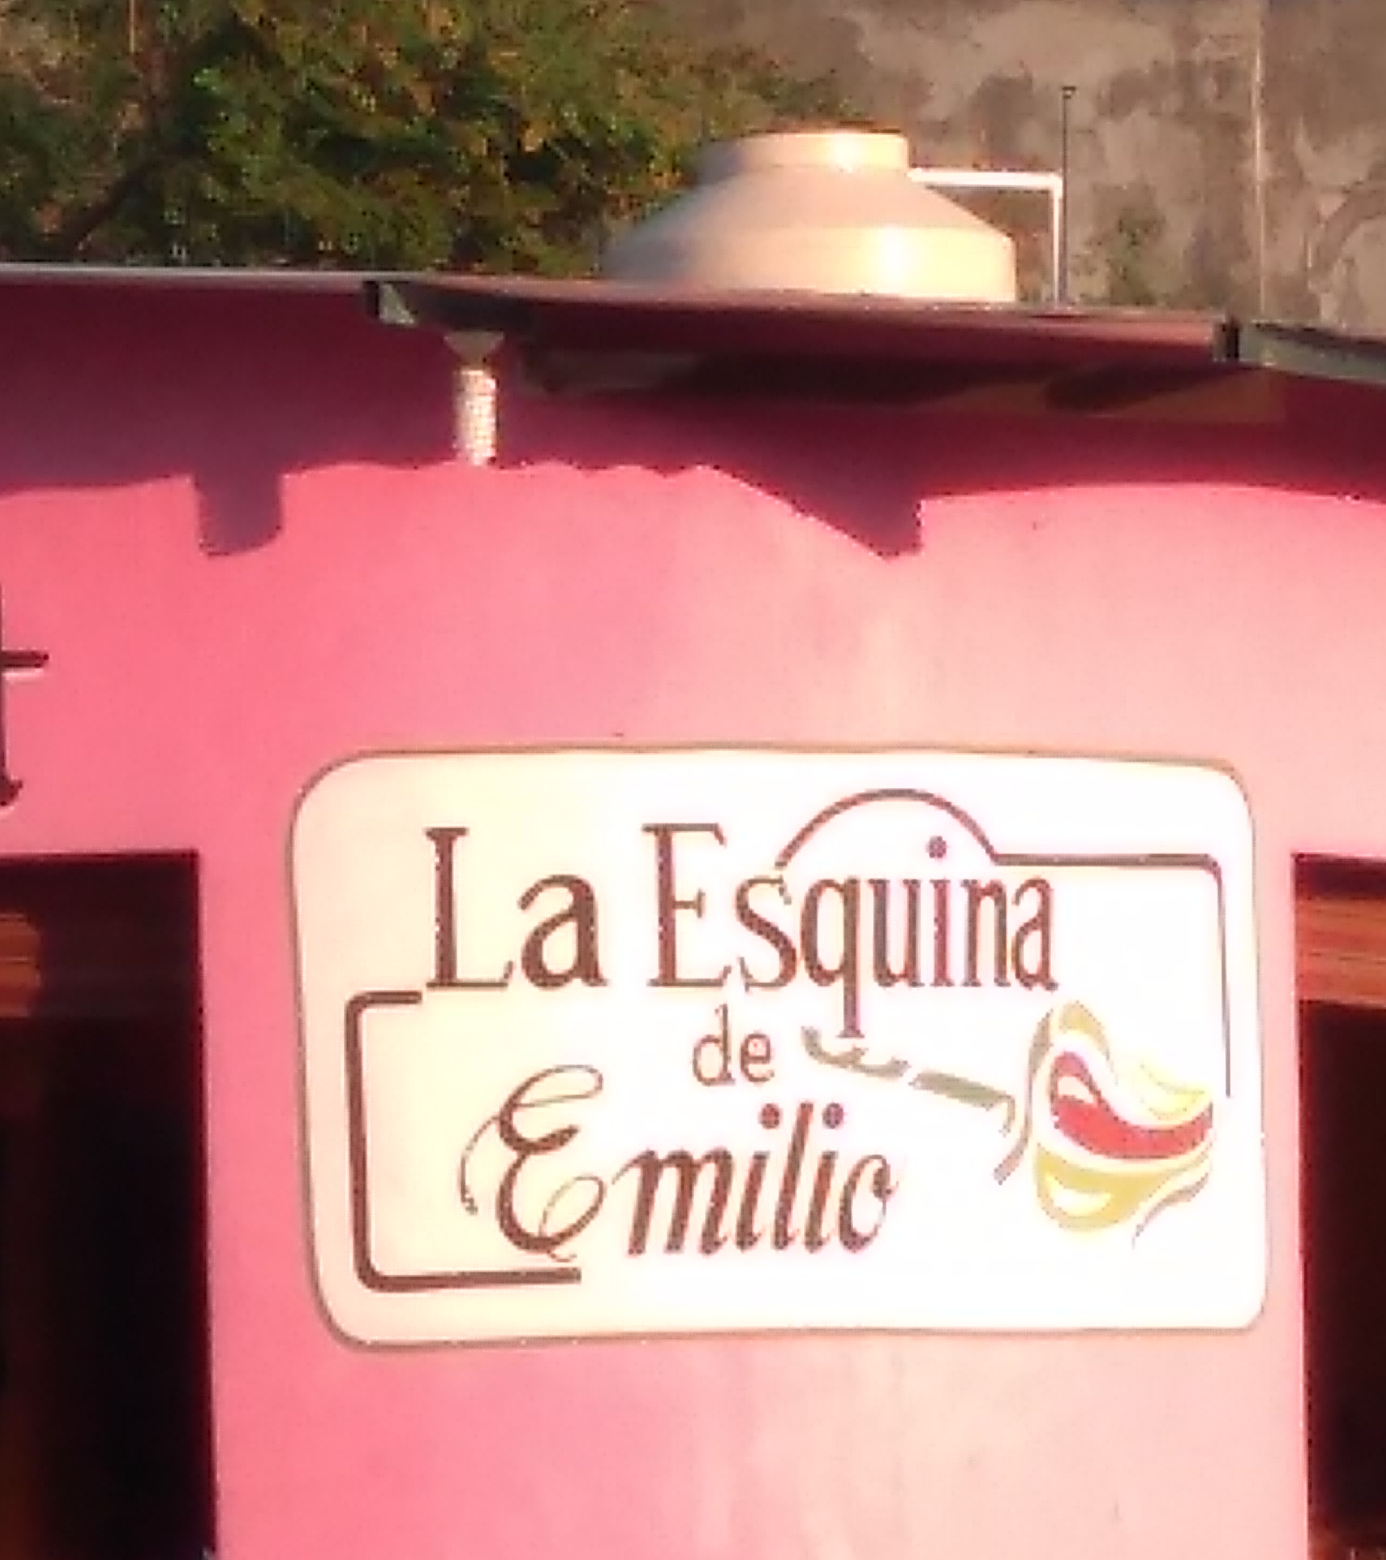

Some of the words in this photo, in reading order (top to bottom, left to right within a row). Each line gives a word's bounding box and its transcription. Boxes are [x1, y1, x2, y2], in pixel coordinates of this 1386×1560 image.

[425, 826, 608, 990] La
[641, 822, 1060, 1039] Esquina
[692, 1003, 776, 1086] de
[458, 1063, 899, 1262] Emilio
